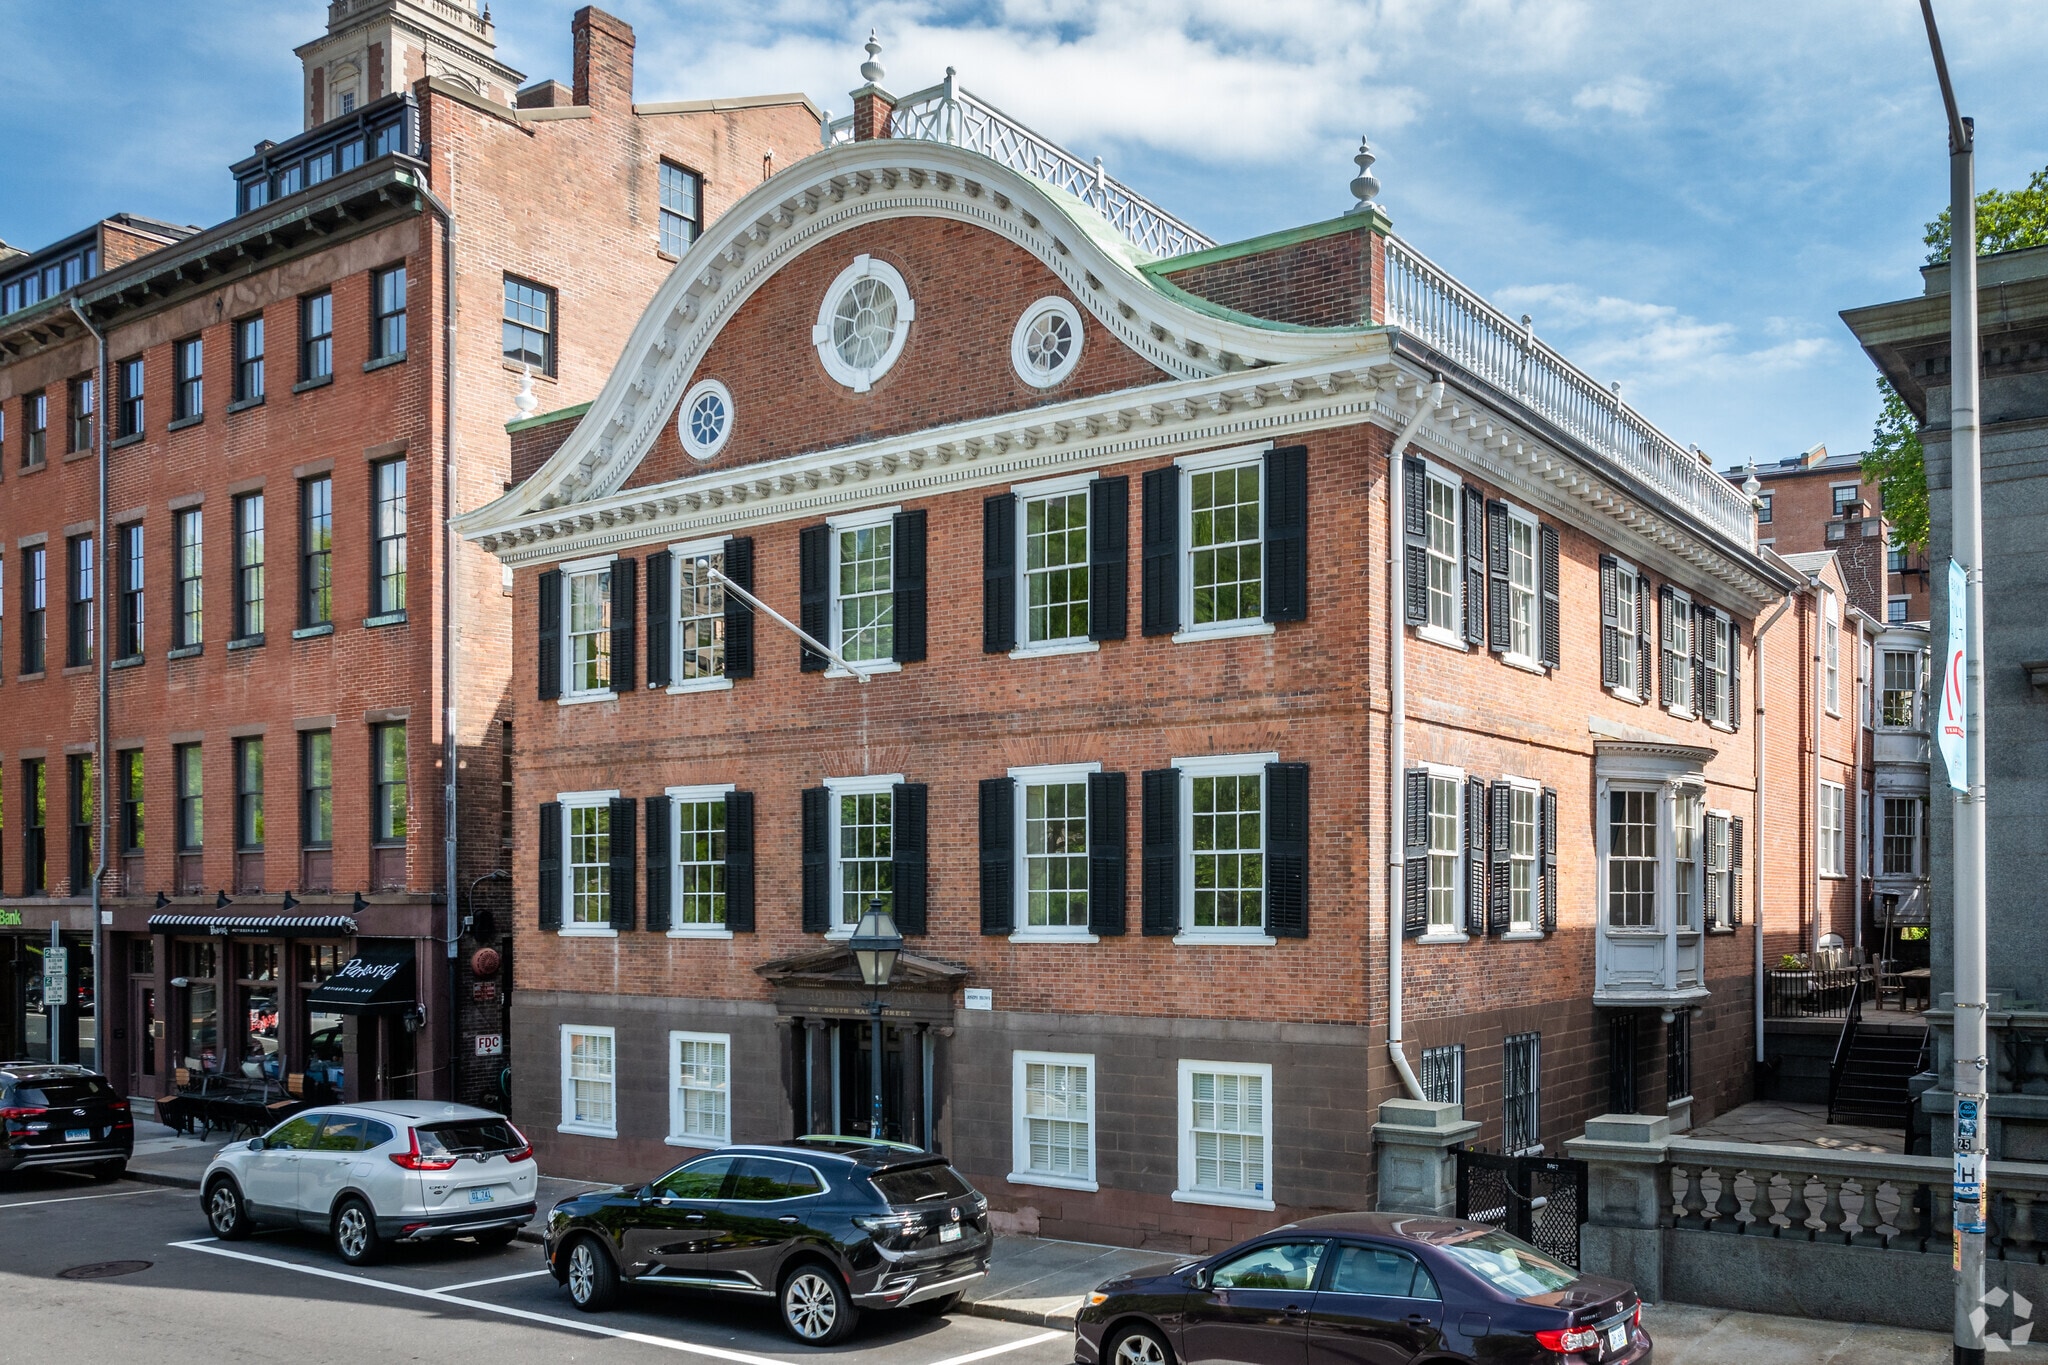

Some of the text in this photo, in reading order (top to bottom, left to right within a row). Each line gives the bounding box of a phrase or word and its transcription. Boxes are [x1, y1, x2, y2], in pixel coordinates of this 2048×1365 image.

[0, 909, 21, 925] Bank
[479, 1037, 499, 1048] FDC
[1958, 1139, 1970, 1150] 25
[1962, 1167, 1975, 1182] H
